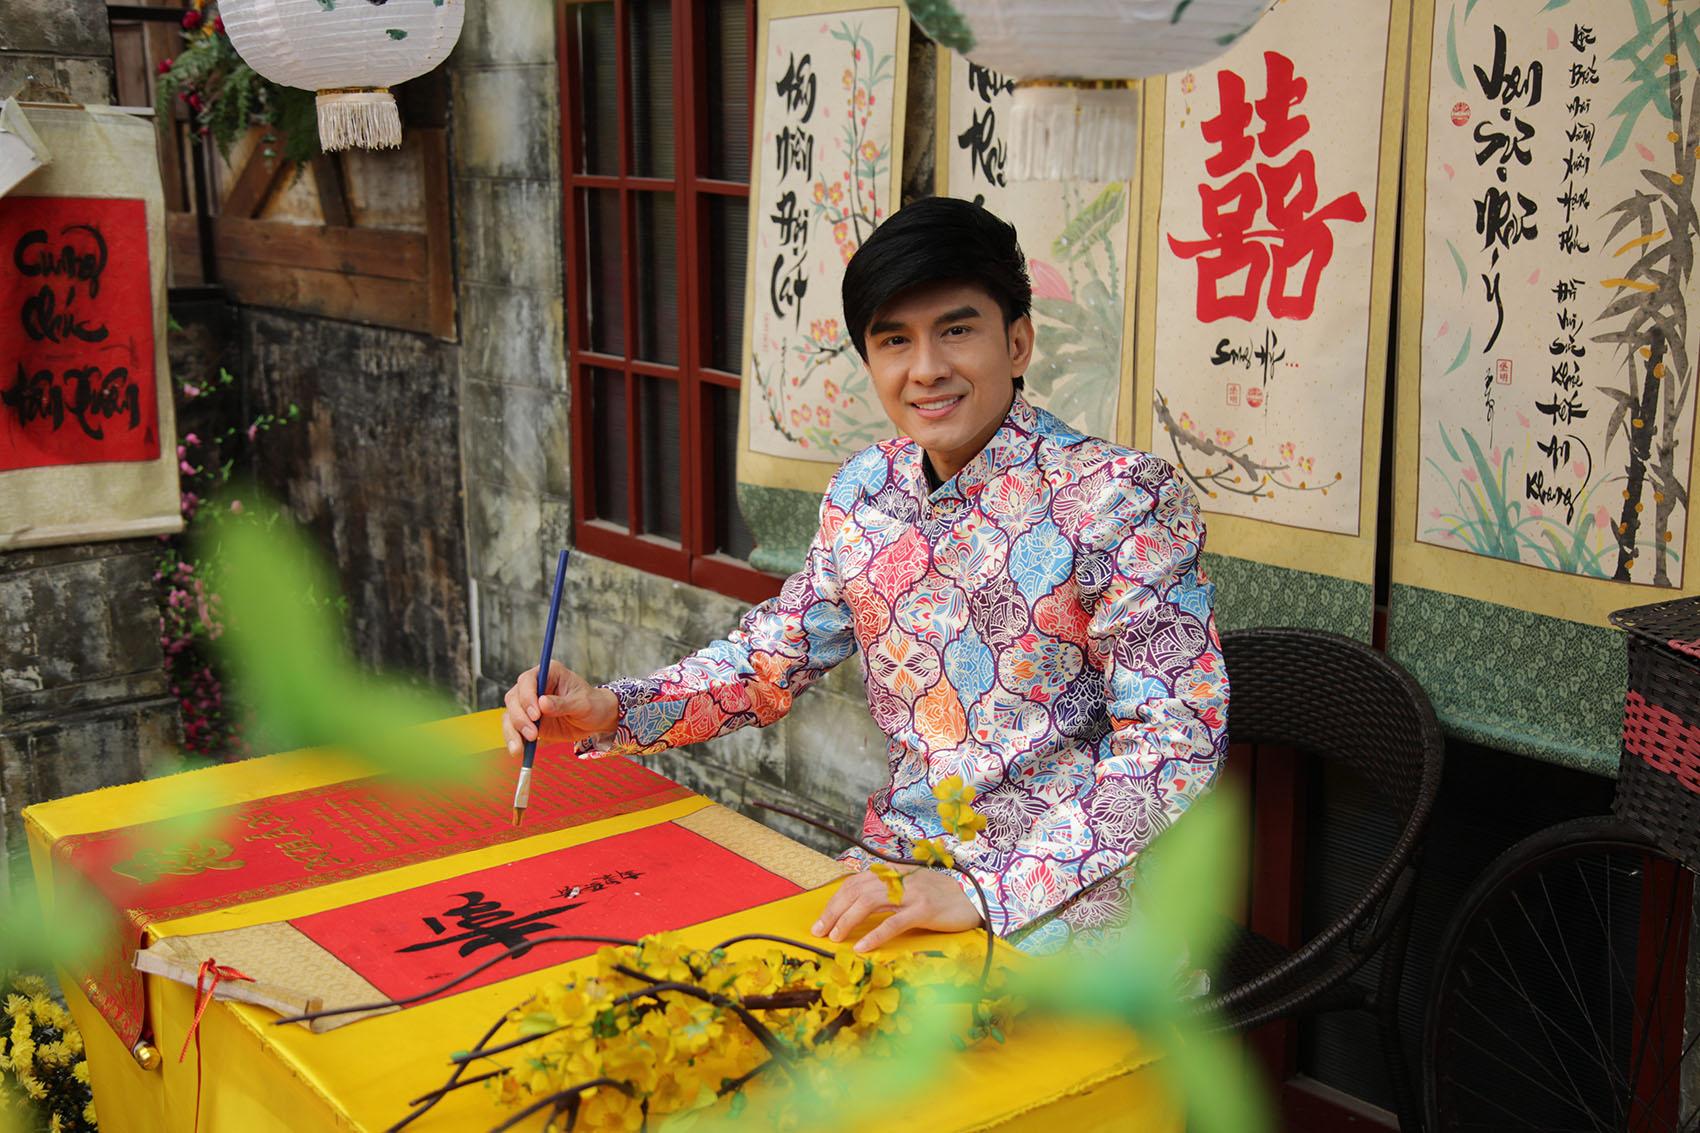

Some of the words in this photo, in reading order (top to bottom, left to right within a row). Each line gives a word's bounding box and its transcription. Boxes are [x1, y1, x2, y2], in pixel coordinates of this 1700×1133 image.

[1473, 24, 1543, 121] Vạn
[1473, 116, 1536, 183] Sự
[1561, 147, 1590, 184] Xuân
[1565, 122, 1595, 152] Vàng
[14, 225, 108, 299] Cung
[21, 285, 109, 344] Chúc
[1526, 433, 1592, 526] Khang
